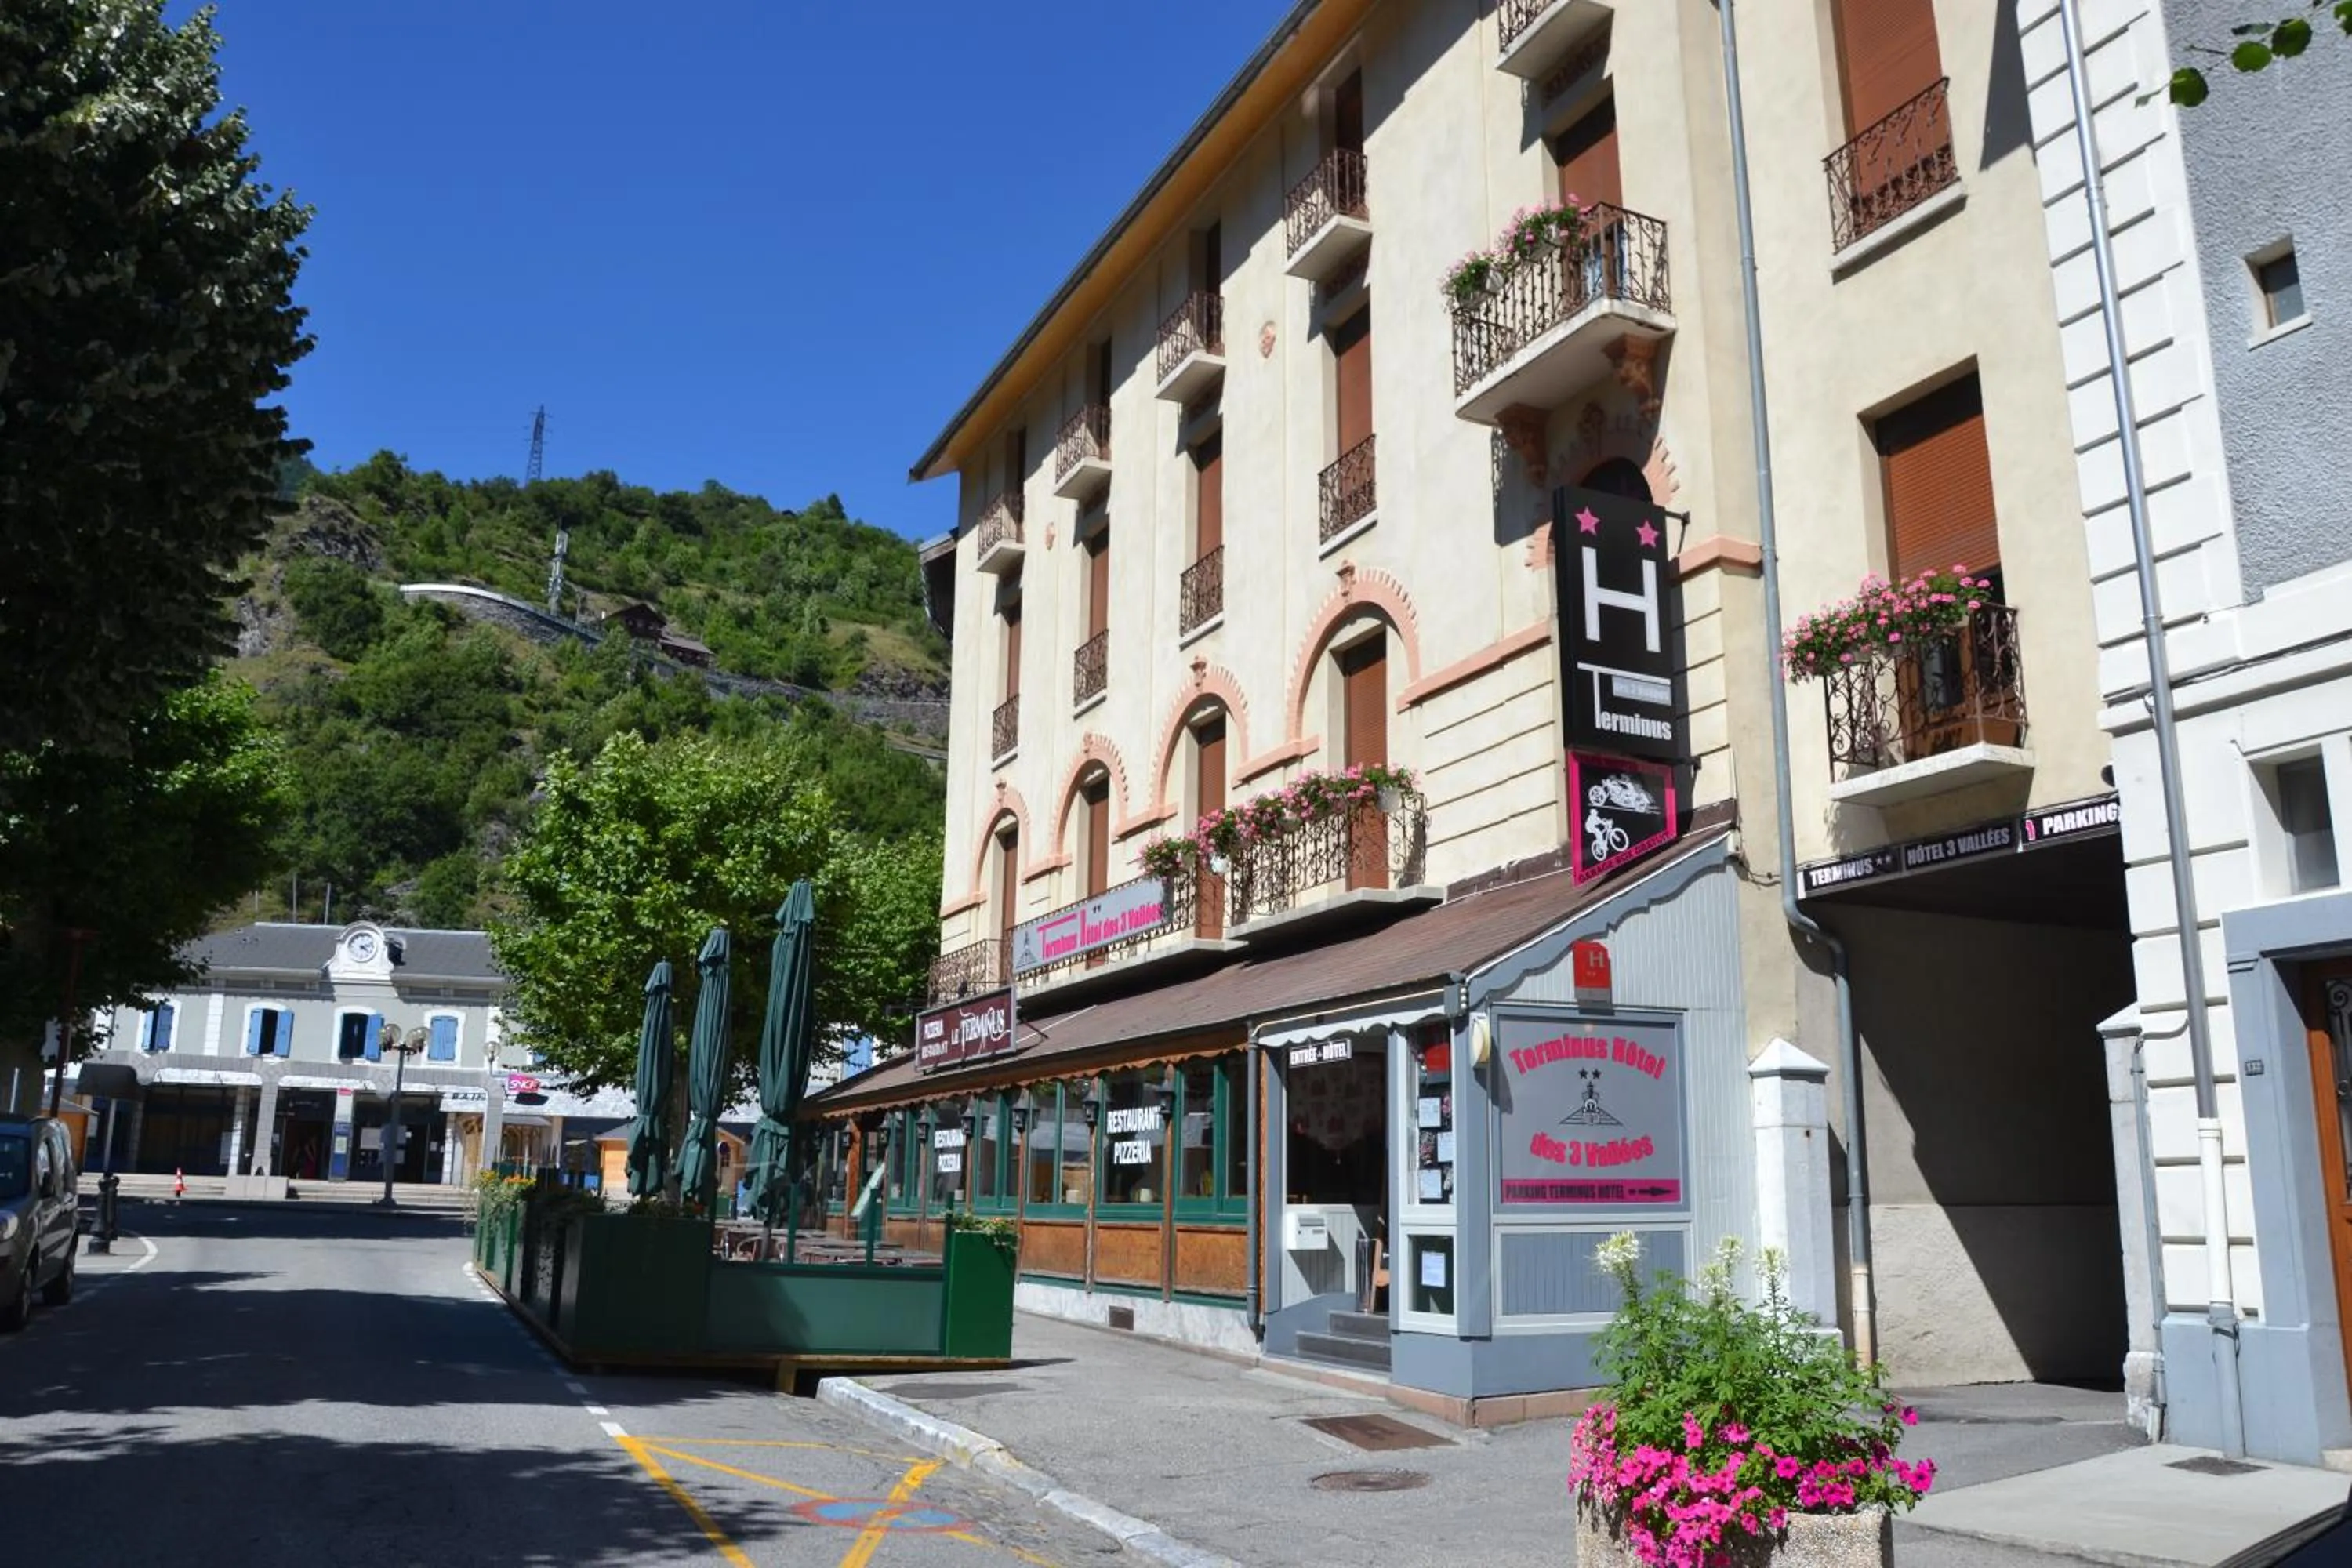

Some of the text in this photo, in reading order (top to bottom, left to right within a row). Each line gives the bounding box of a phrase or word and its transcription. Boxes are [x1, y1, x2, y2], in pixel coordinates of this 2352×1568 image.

[1582, 546, 1661, 652] H
[1577, 661, 1671, 740] Terminus
[2042, 803, 2117, 835] PARKING
[1907, 828, 2009, 866] HÔTEL 3 VALLÉES
[1809, 858, 1874, 887] TERMINUS
[1036, 913, 1078, 960] Terminus
[1589, 950, 1605, 968] H
[1508, 1033, 1608, 1075] Terminus
[1107, 1105, 1161, 1134] RESTAURANT
[1114, 1139, 1152, 1164] PIZZERIA
[1530, 1131, 1654, 1167] des 3 Vallées
[1505, 1185, 1547, 1199] PARKING
[1549, 1185, 1595, 1199] TERMINUS
